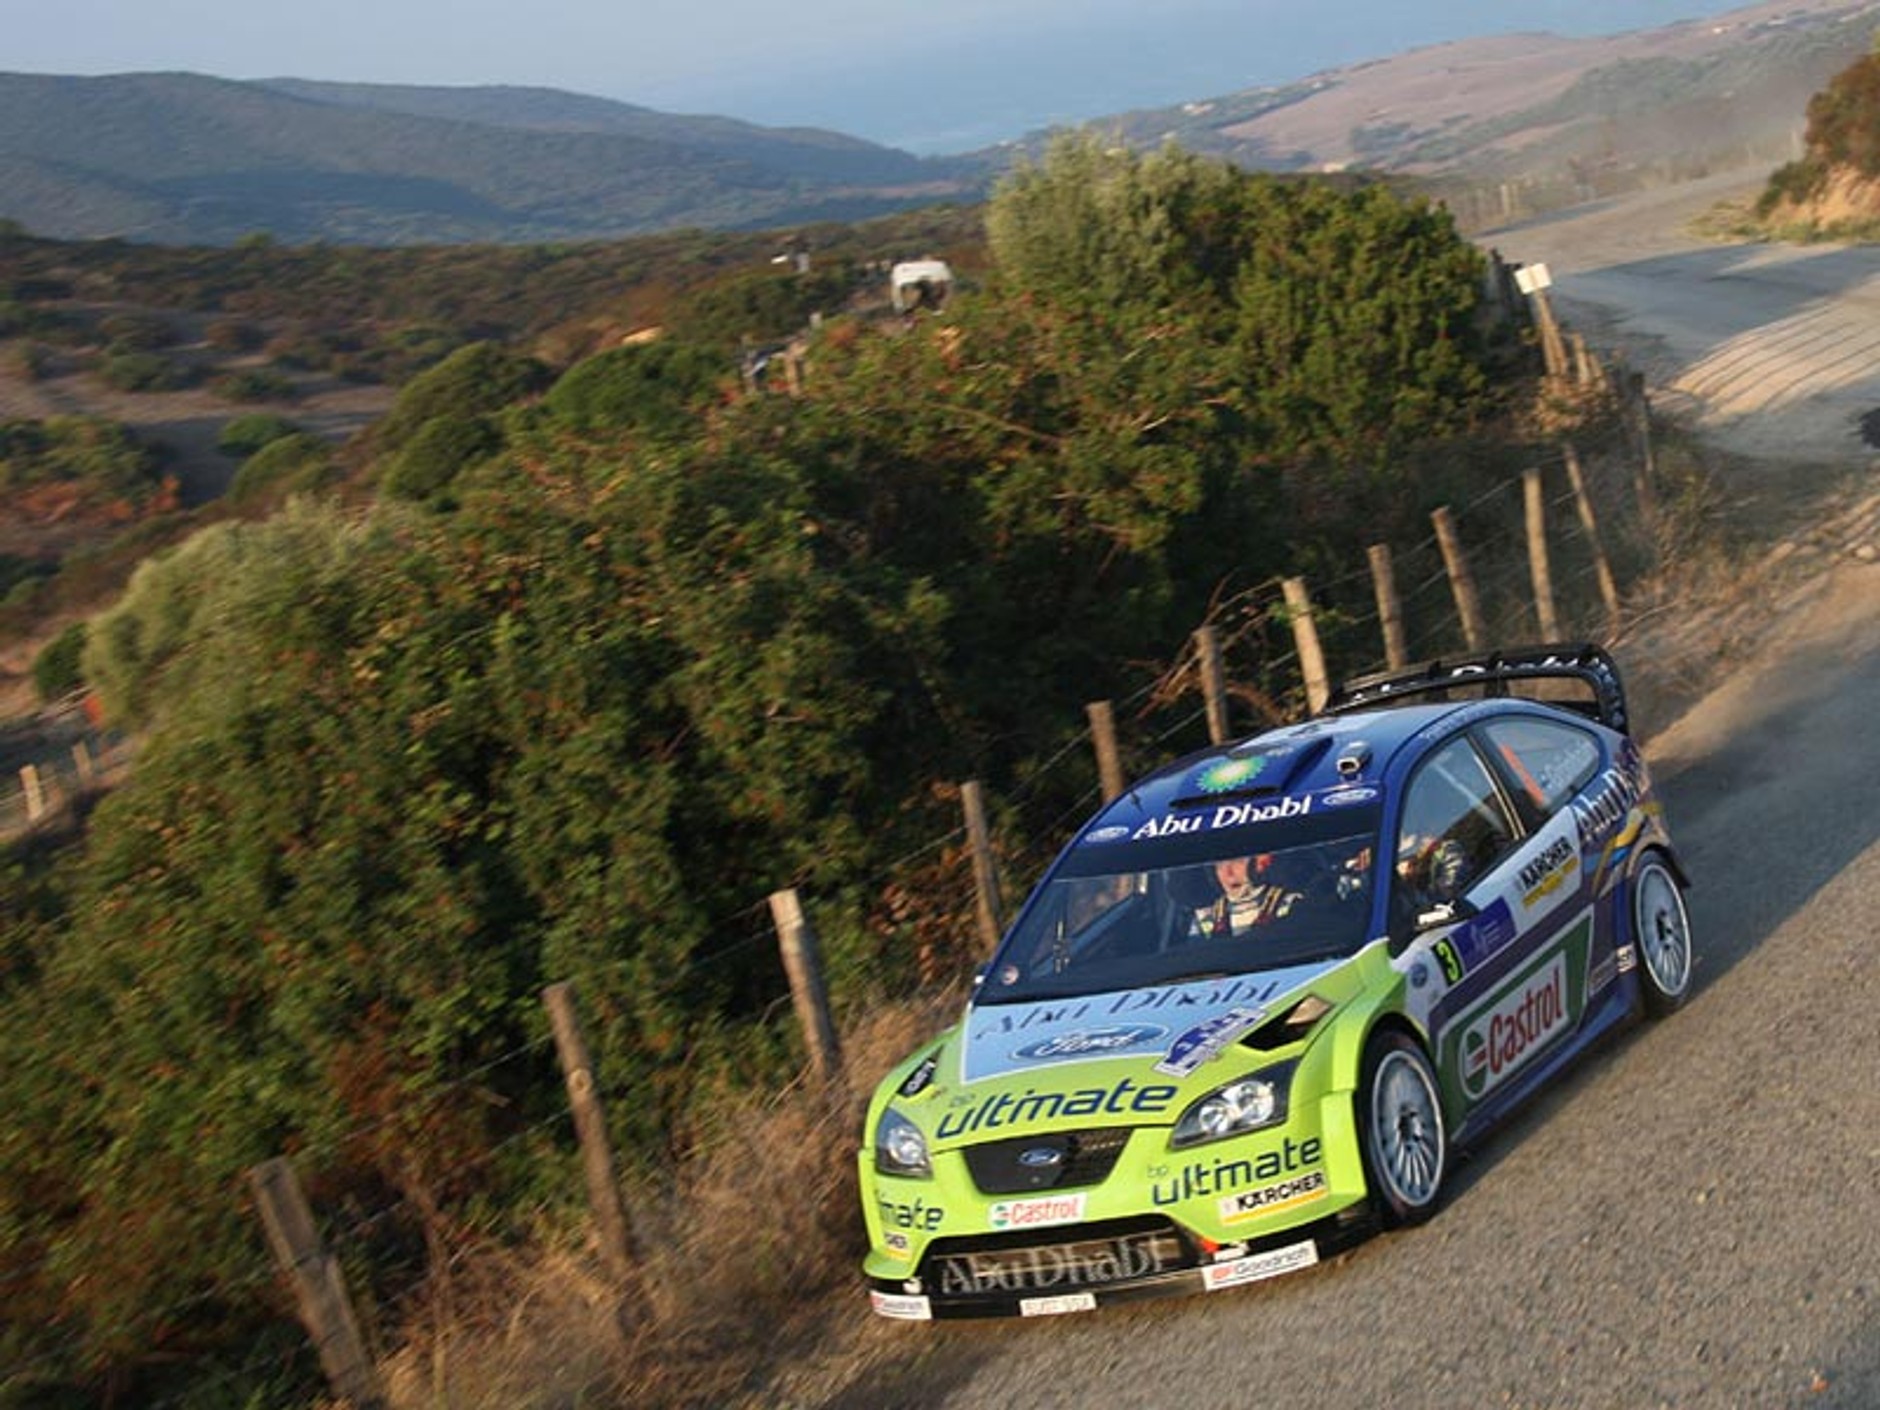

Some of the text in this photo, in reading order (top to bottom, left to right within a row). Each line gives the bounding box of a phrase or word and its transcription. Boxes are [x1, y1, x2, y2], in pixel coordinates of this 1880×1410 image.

[1131, 816, 1202, 840] Abu
[1211, 794, 1312, 829] Dhabi
[1434, 940, 1463, 983] 3
[1489, 966, 1562, 1075] Castrol
[936, 1078, 1178, 1140] ultimate
[1152, 1136, 1321, 1206] ultimate
[1011, 1197, 1079, 1224] Castrol
